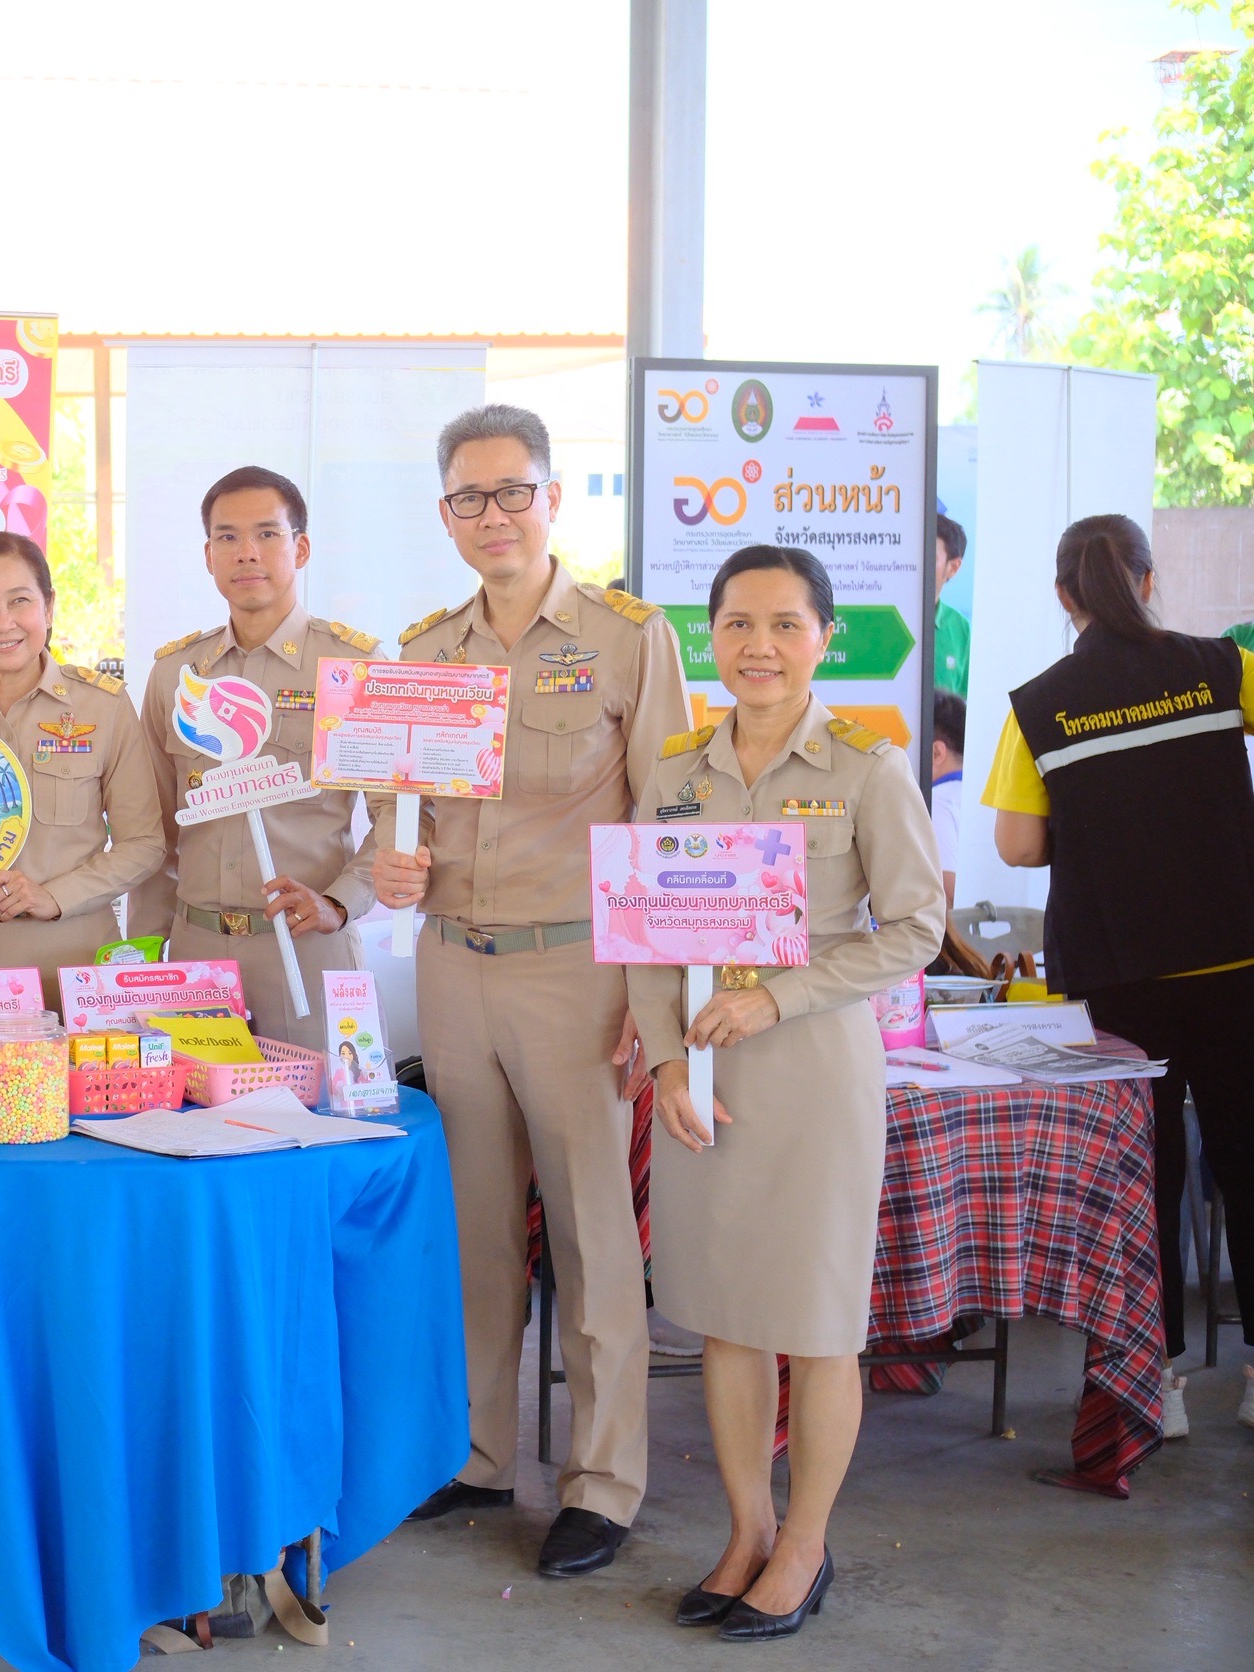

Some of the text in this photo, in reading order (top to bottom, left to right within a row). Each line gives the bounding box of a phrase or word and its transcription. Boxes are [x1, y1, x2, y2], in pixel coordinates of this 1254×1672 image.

[774, 465, 901, 513] ส่วนหน้า
[775, 526, 901, 550] จังหวัดสมุทรสงคราม
[861, 560, 917, 573] วิจัยและนวัตกรรม
[366, 681, 493, 703] ประเภทเงินทุนหมุนเวียน
[1056, 682, 1213, 736] โทรคมนาคมแห่งชาติ
[205, 760, 274, 783] กองทุนพัฒนา
[190, 766, 298, 806] บทบาทสตรี
[180, 785, 316, 822] Thai Women Empowerment Funds
[667, 874, 728, 885] คลินิกเคลื่อนที่
[607, 893, 792, 913] กองทุนพัฒนาบทบาทสตรี
[646, 916, 751, 930] จังหวัดสมุทรสงคราม
[123, 974, 179, 983] รับสมัครสมาชิก
[77, 987, 230, 1010] กองทุนพัฒนาบทบาทสตรี
[148, 1042, 164, 1051] Unif
[145, 1051, 169, 1066] fresh
